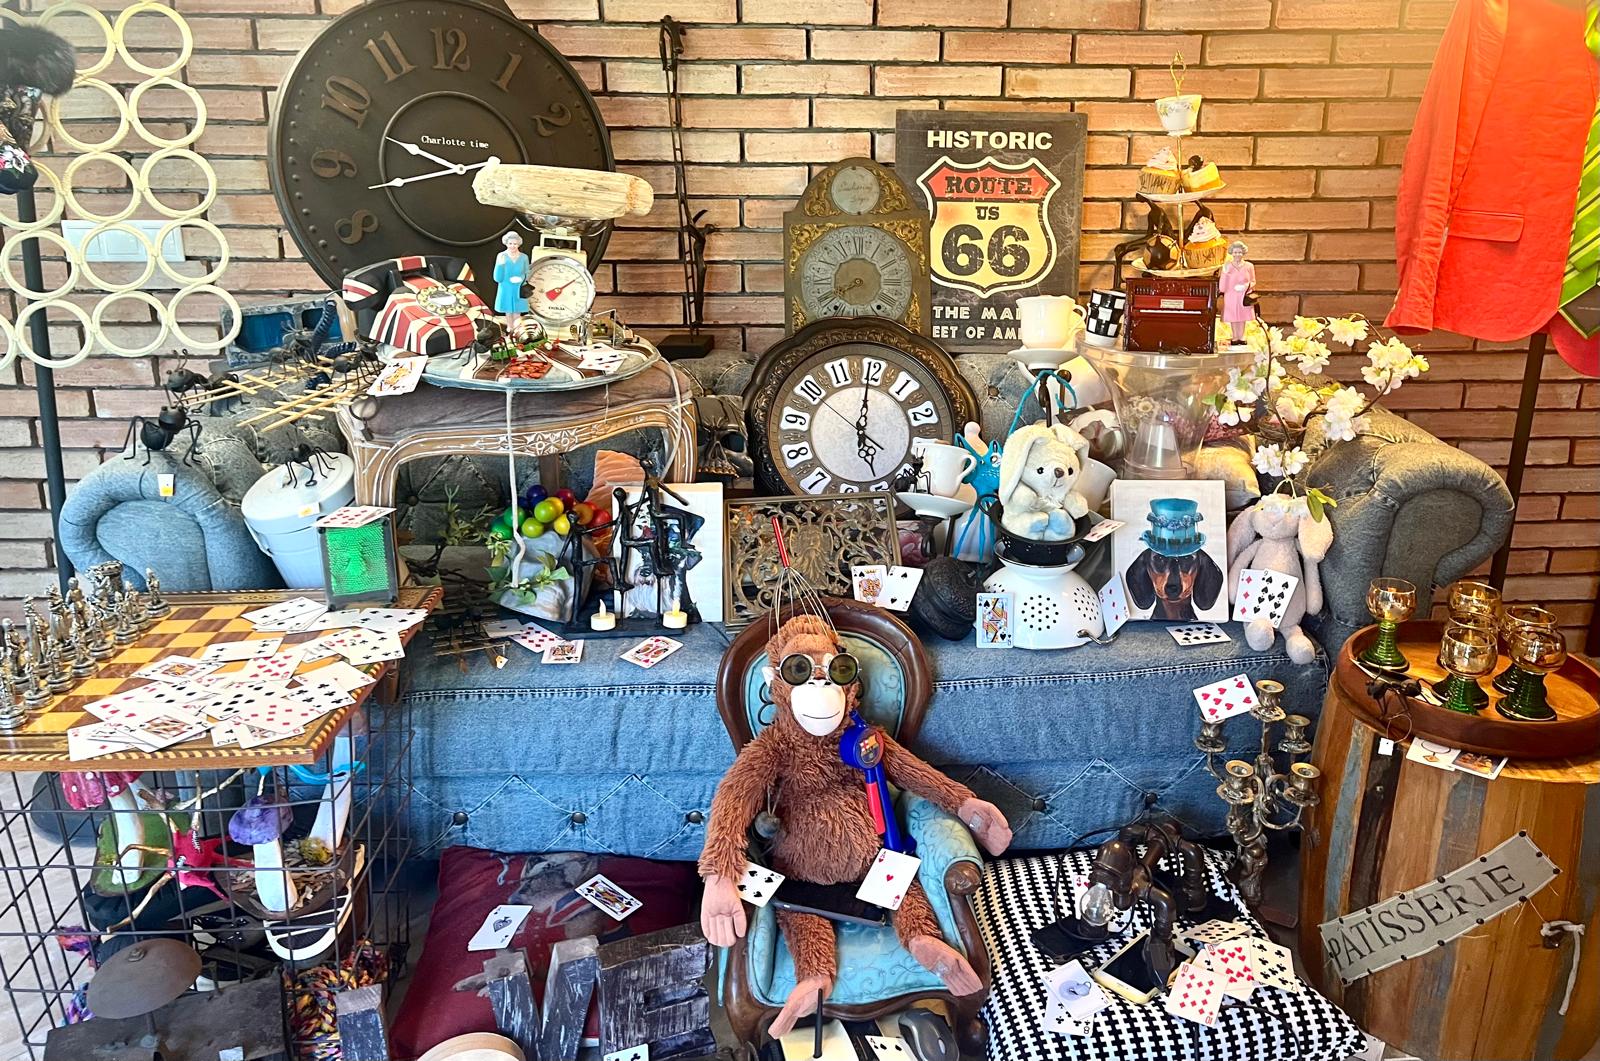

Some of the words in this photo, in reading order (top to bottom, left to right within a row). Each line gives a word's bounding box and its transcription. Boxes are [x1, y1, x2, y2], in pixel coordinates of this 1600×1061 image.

[363, 30, 417, 83] 11
[429, 26, 472, 71] 12
[490, 51, 523, 93] 1
[320, 75, 371, 129] 10
[531, 102, 572, 138] 2
[421, 135, 466, 147] Charlotte
[470, 139, 490, 149] time
[927, 130, 1053, 150] HISTORIC
[310, 150, 358, 179] 9
[944, 176, 1033, 195] ROUTE
[975, 206, 1000, 221] US
[334, 208, 379, 246] 8
[941, 223, 1031, 277] 66
[932, 305, 971, 319] THE
[965, 326, 986, 339] OF
[831, 362, 849, 385] 11
[864, 361, 882, 382] 12
[800, 379, 823, 402] 10
[894, 379, 912, 396] 1
[785, 413, 807, 426] 9
[912, 407, 934, 422] 2
[786, 446, 809, 460] 8
[807, 470, 828, 490] 7
